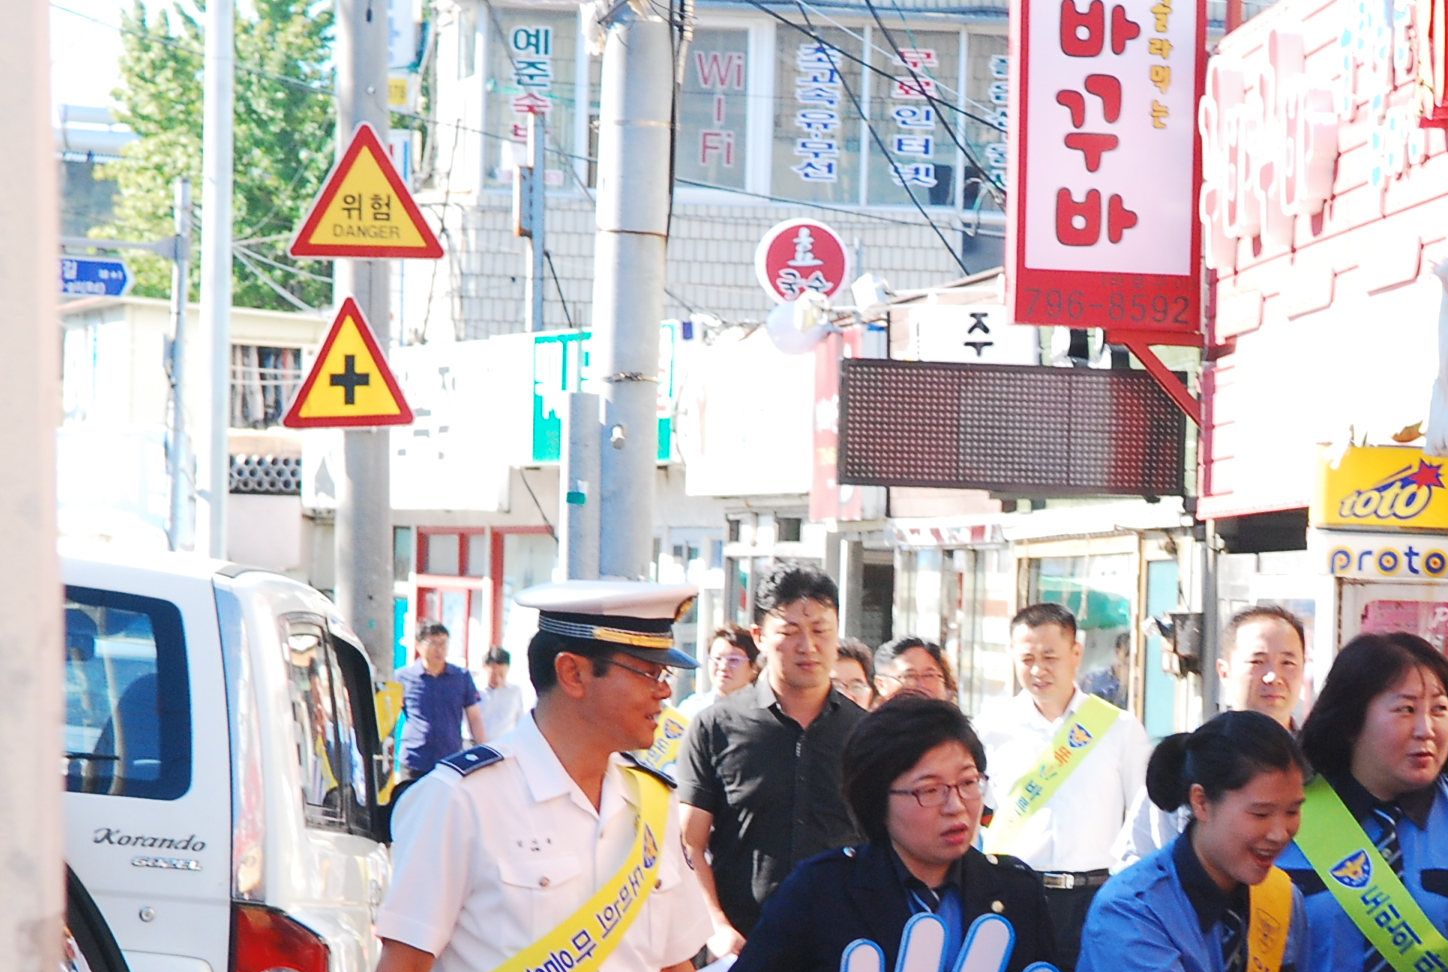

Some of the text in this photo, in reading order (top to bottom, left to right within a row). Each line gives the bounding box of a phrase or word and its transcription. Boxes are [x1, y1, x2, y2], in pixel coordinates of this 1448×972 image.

[342, 193, 391, 221] 위험
[333, 224, 400, 239] DANGER
[1024, 288, 1191, 325] 796-8592
[1338, 480, 1432, 520] toto
[1330, 546, 1447, 575] proto
[93, 827, 207, 853] Korando
